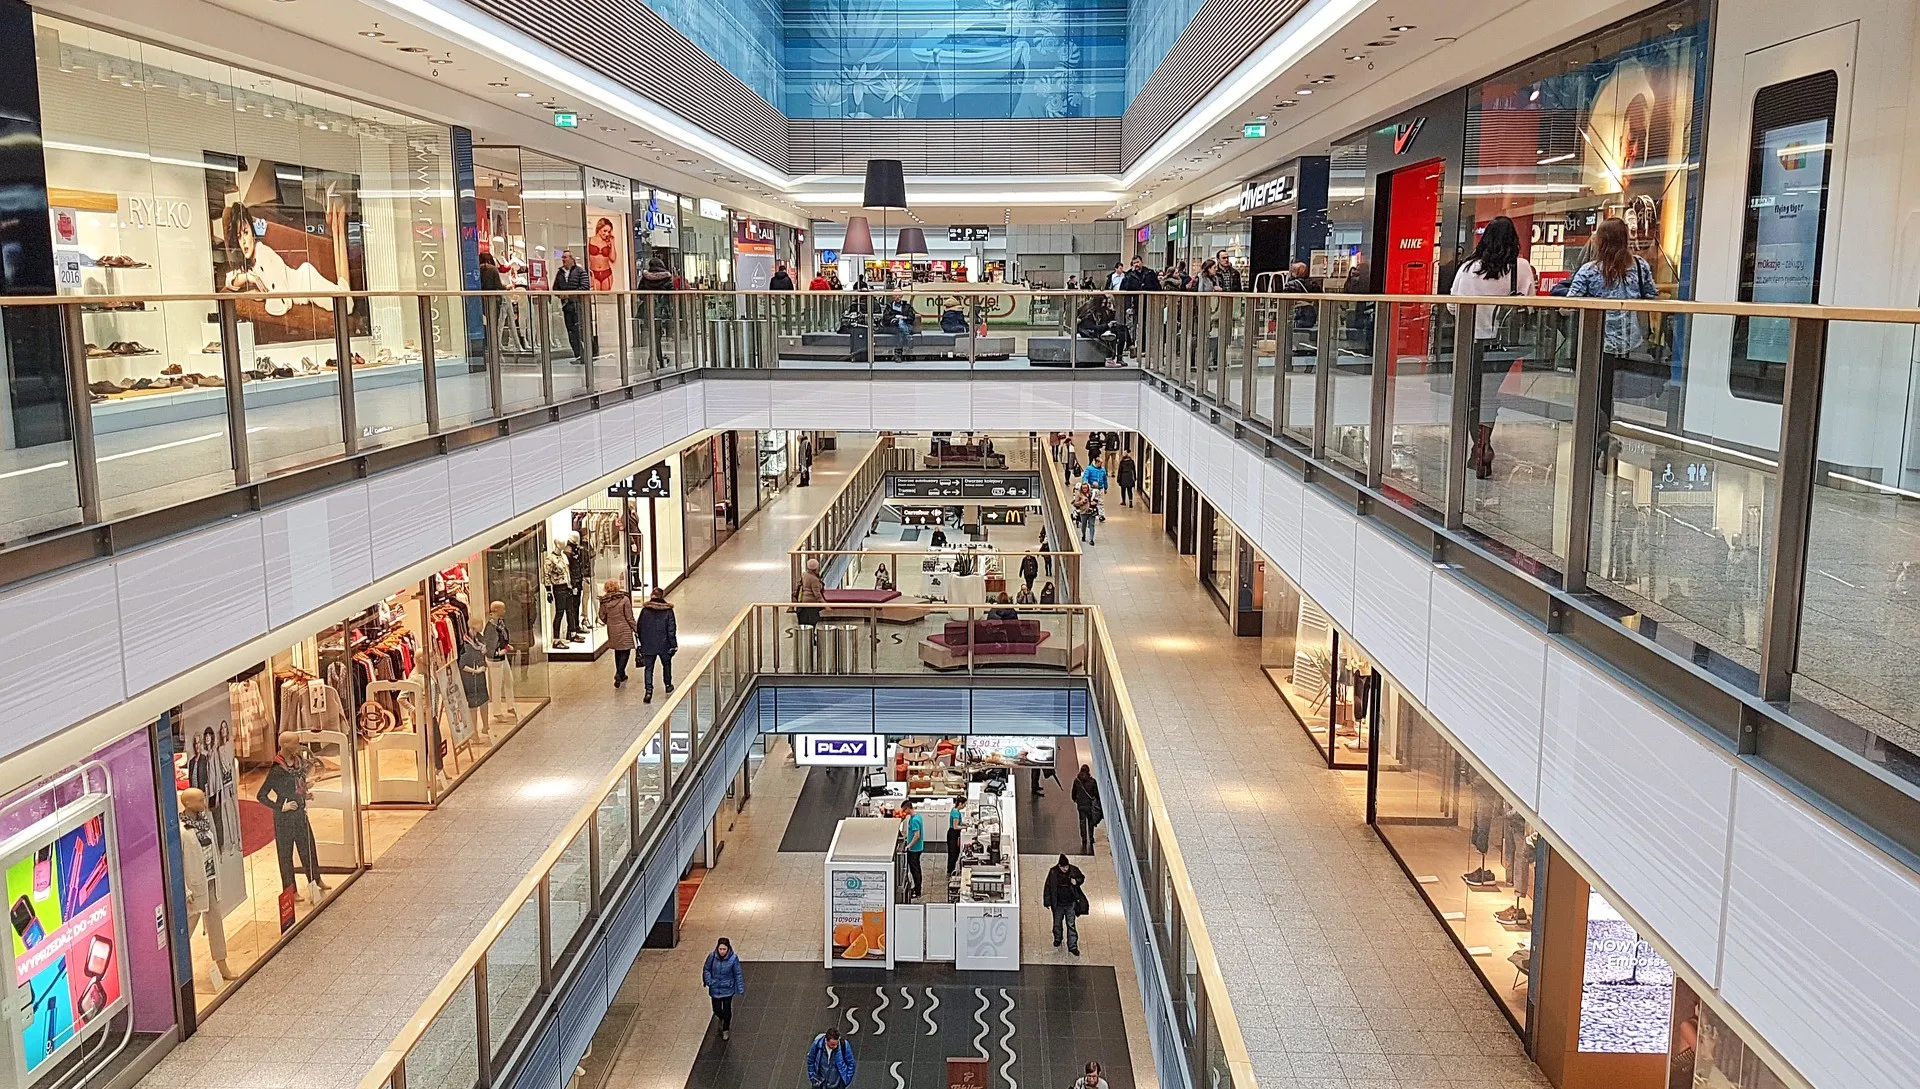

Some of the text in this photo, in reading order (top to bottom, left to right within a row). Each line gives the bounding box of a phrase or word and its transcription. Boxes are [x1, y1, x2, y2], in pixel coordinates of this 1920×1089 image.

[1240, 175, 1286, 212] diverse
[128, 196, 192, 229] RYŁKO
[965, 228, 973, 238] P
[1399, 238, 1424, 249] NIKE
[61, 270, 80, 283] 2016
[818, 742, 864, 754] PLAY
[972, 740, 990, 748] 5,90
[17, 927, 73, 976] WYPRZEDAŻ
[73, 921, 87, 936] DO
[1593, 940, 1641, 952] NOWY
